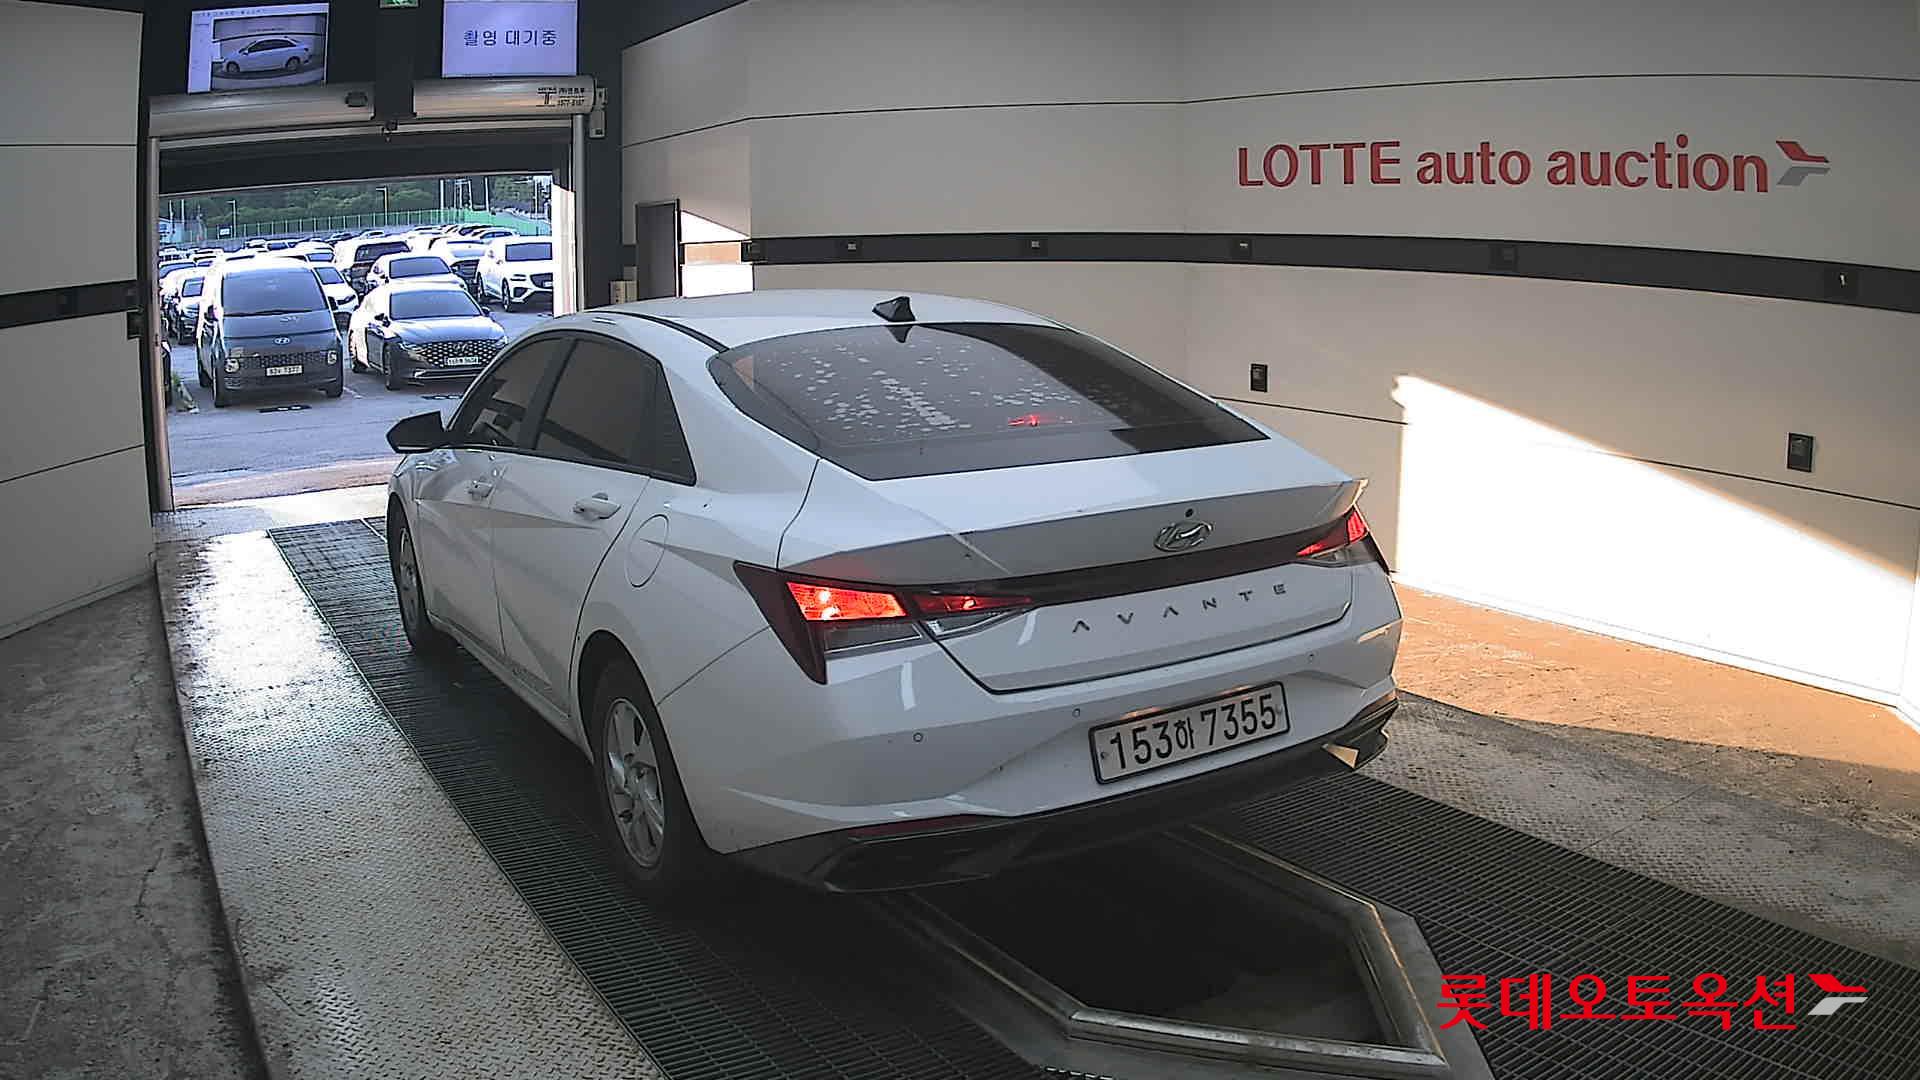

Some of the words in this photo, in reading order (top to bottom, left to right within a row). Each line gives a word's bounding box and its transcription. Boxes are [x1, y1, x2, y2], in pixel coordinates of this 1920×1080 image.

[504, 29, 557, 46] 대기중
[1238, 140, 1401, 188] LOTTE
[1416, 142, 1533, 187] auto
[1546, 134, 1769, 193] auction
[1071, 583, 1287, 634] AVANTE
[1110, 716, 1195, 770] 153하
[1200, 694, 1277, 746] 7355
